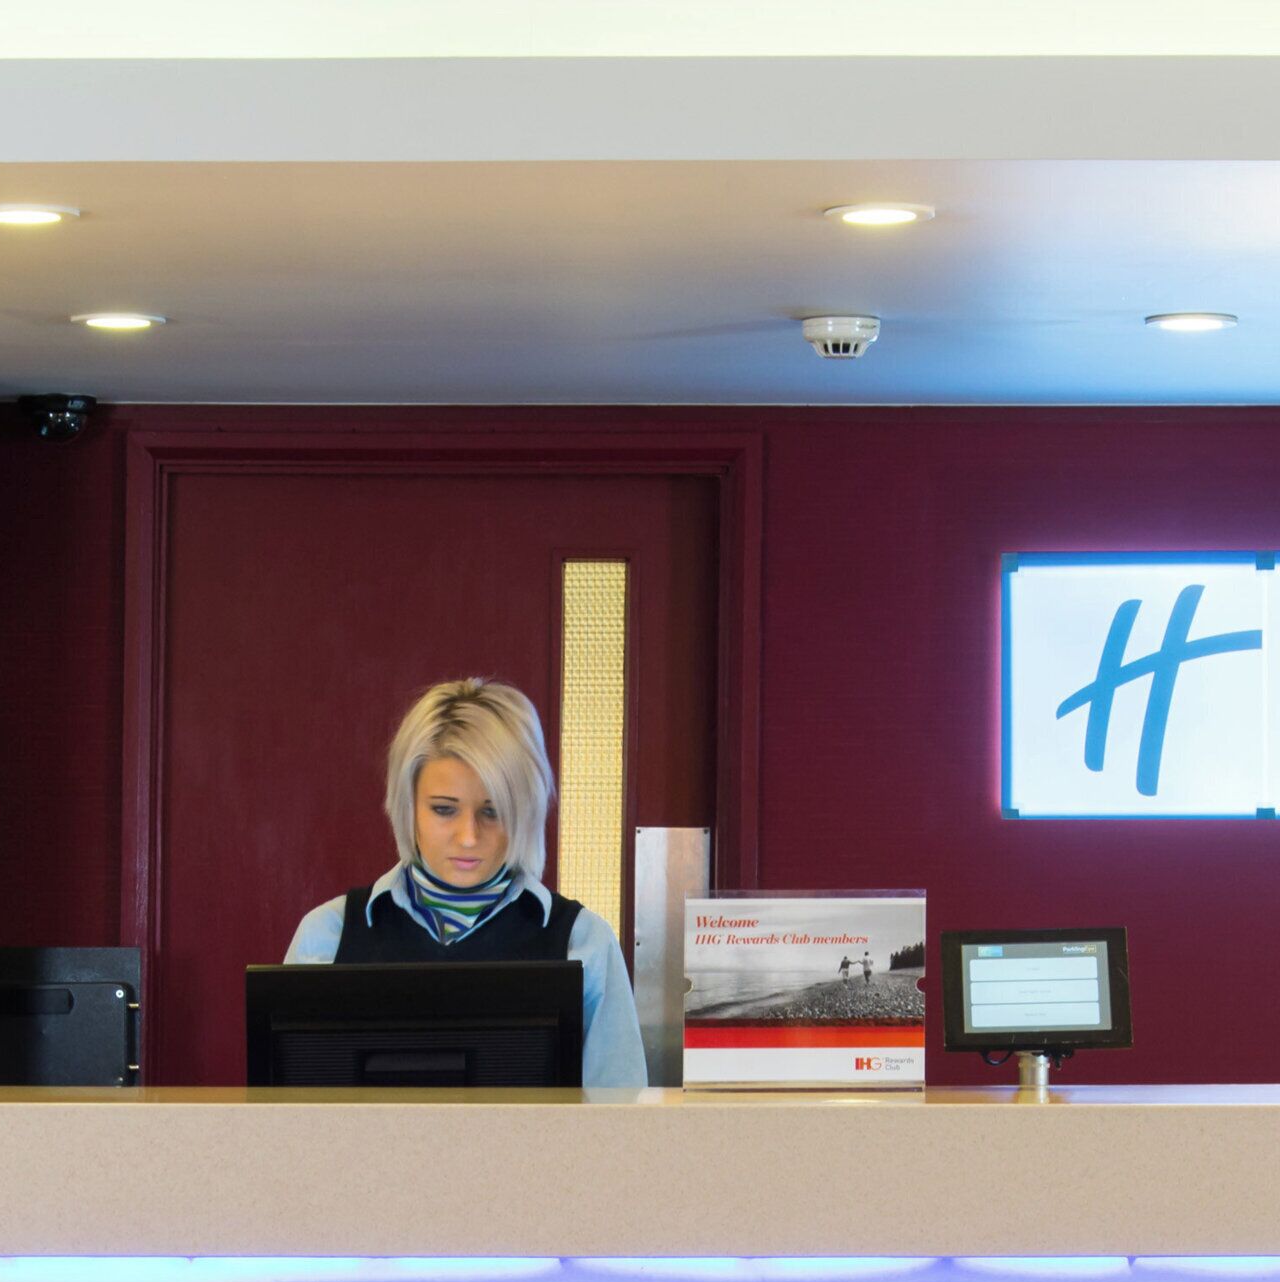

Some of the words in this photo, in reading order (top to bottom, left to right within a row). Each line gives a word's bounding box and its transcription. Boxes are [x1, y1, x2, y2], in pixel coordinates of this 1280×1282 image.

[695, 915, 760, 929] Welcome
[726, 933, 780, 946] Rewards
[782, 932, 811, 946] Club
[812, 932, 870, 946] members
[855, 1056, 882, 1071] IHG
